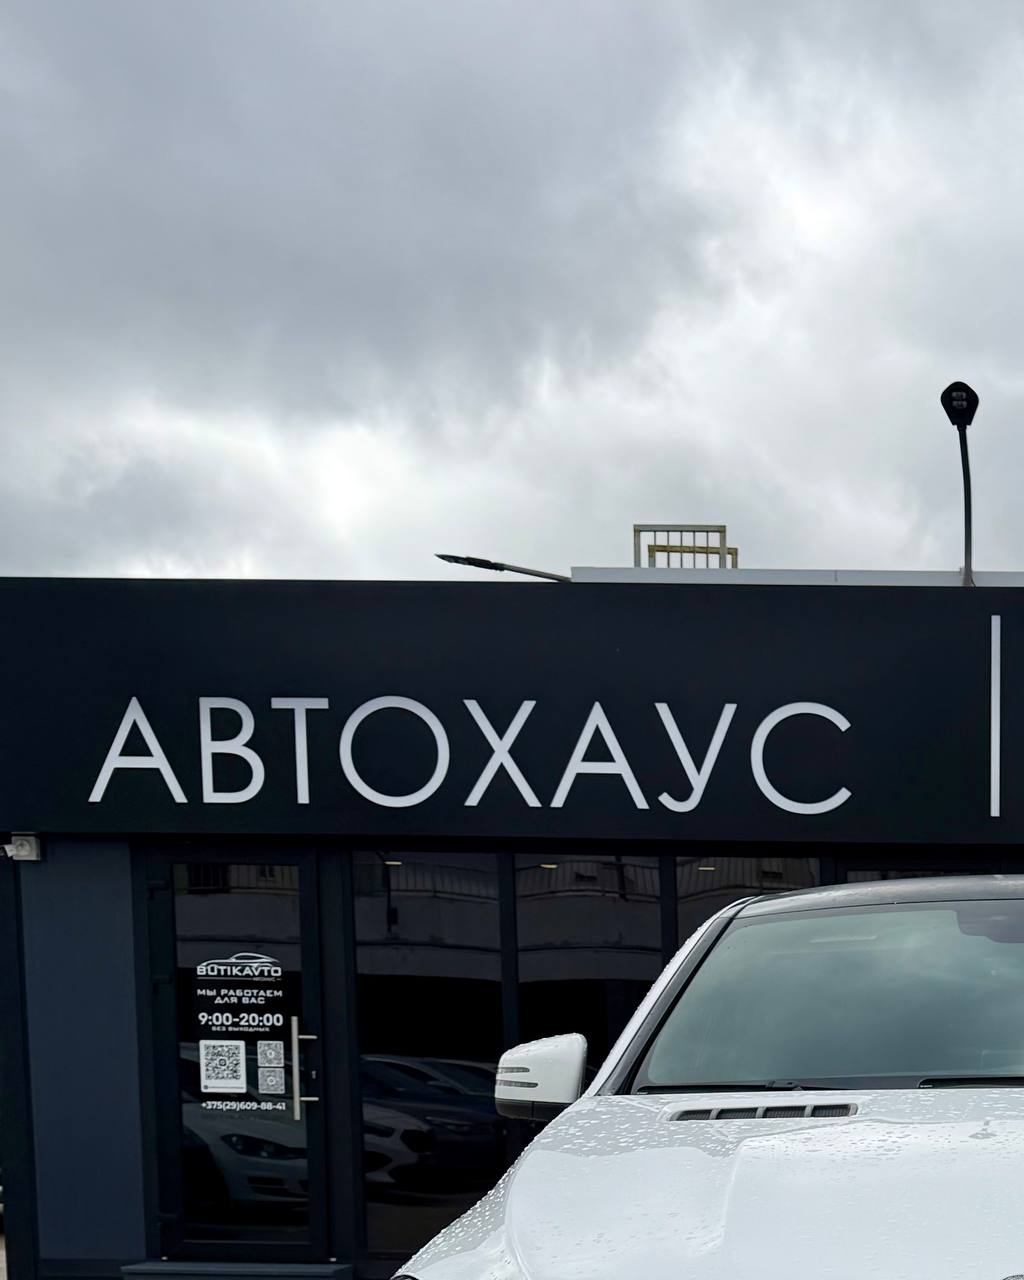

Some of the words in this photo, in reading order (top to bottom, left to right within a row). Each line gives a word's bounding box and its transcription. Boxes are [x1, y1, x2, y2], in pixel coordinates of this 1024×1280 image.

[88, 695, 852, 815] АВТОХАУС
[196, 965, 282, 977] BUTIKAVTO
[197, 988, 217, 997] МЫ
[220, 988, 283, 998] РАБОТАЕМ
[241, 997, 266, 1005] ВАС
[198, 1012, 284, 1027] 9:00-20:00
